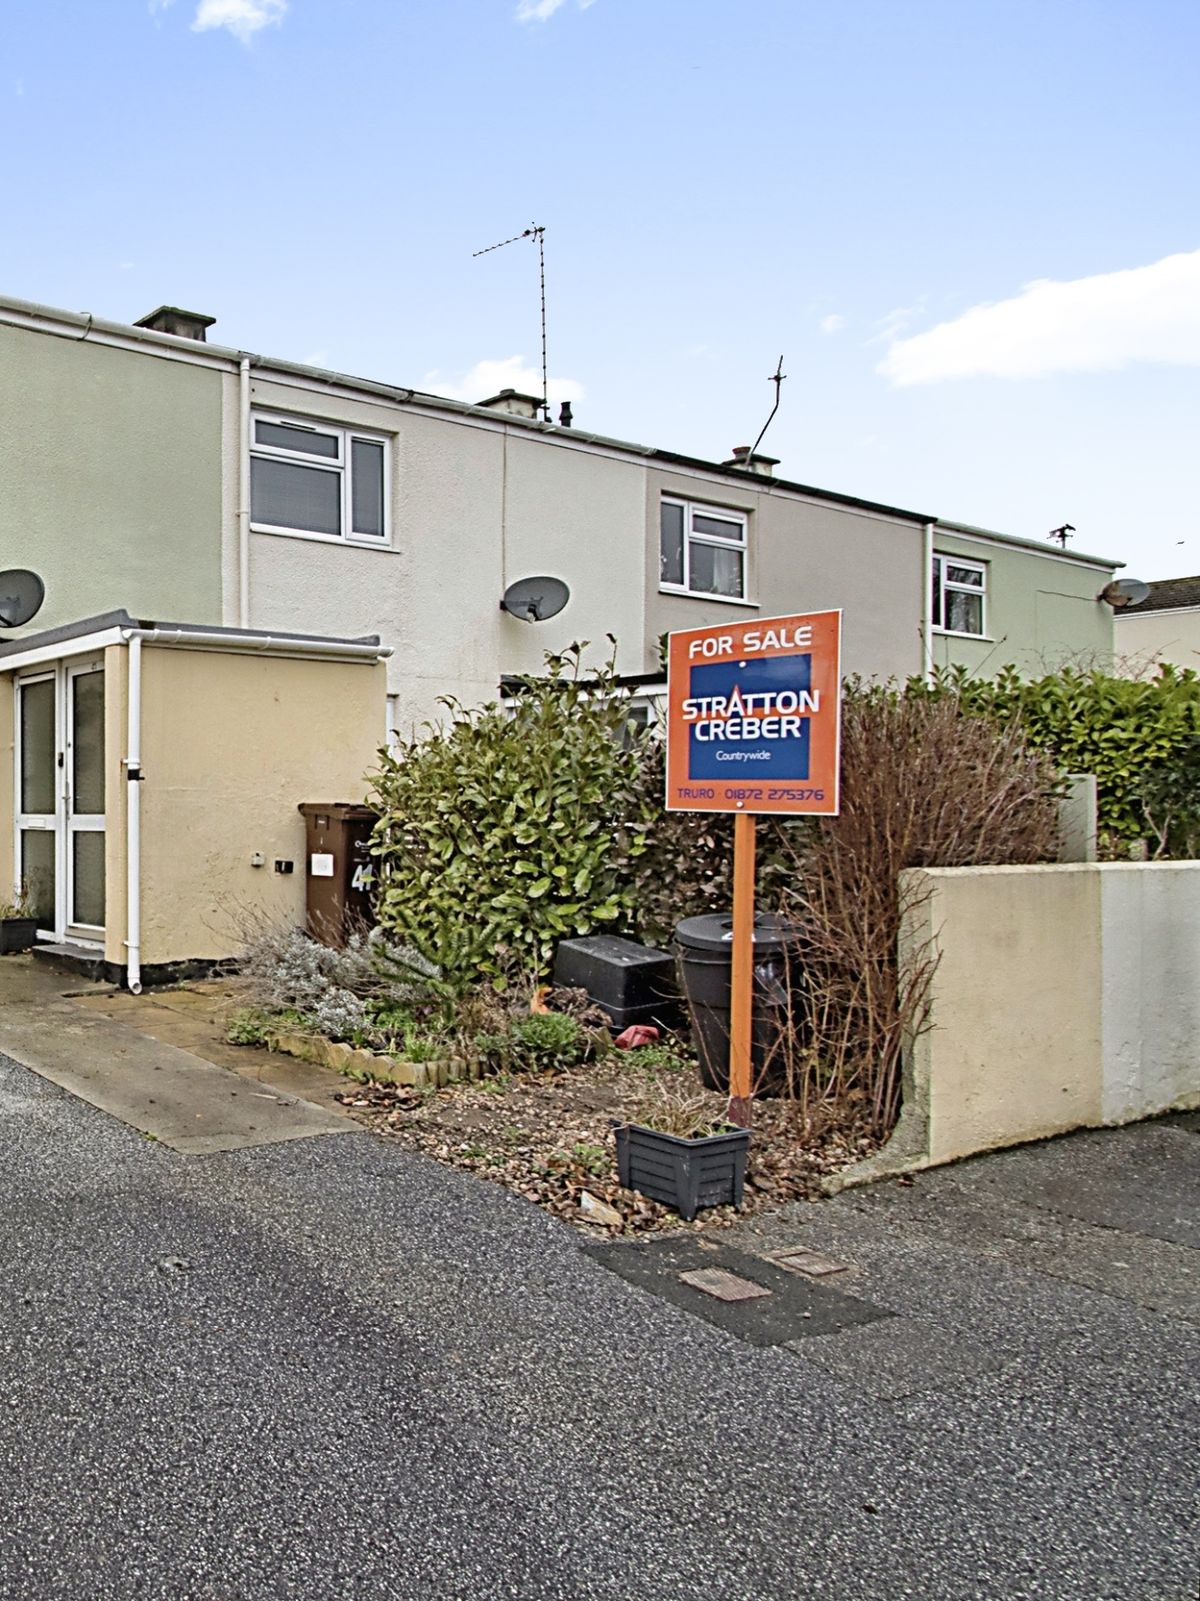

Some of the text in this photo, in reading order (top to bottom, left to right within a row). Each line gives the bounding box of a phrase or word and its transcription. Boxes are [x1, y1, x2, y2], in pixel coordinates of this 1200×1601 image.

[689, 626, 812, 659] FOR SALE
[682, 685, 820, 720] STRATTON
[695, 715, 801, 741] CREBER
[716, 750, 771, 762] Countrywide
[677, 788, 825, 800] TRURO 01872 275376
